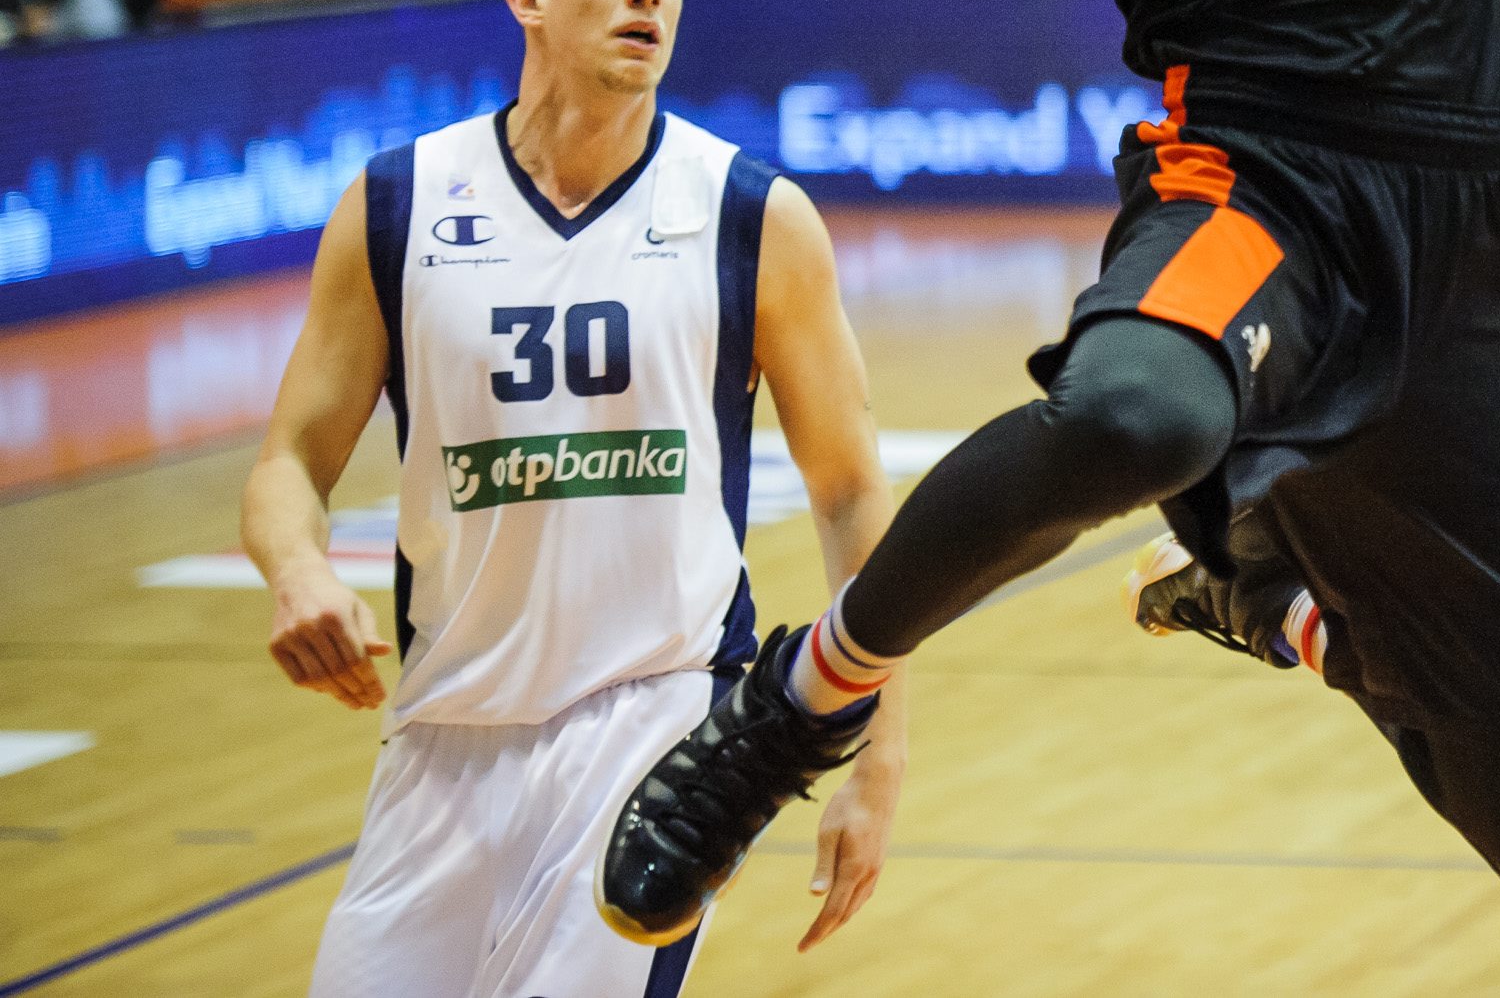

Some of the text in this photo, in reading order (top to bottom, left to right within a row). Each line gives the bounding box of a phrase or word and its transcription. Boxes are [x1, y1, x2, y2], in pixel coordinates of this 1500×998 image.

[778, 82, 1068, 190] Expand
[419, 255, 511, 269] Champion
[490, 300, 631, 403] 30
[490, 435, 686, 496] otpbanka
